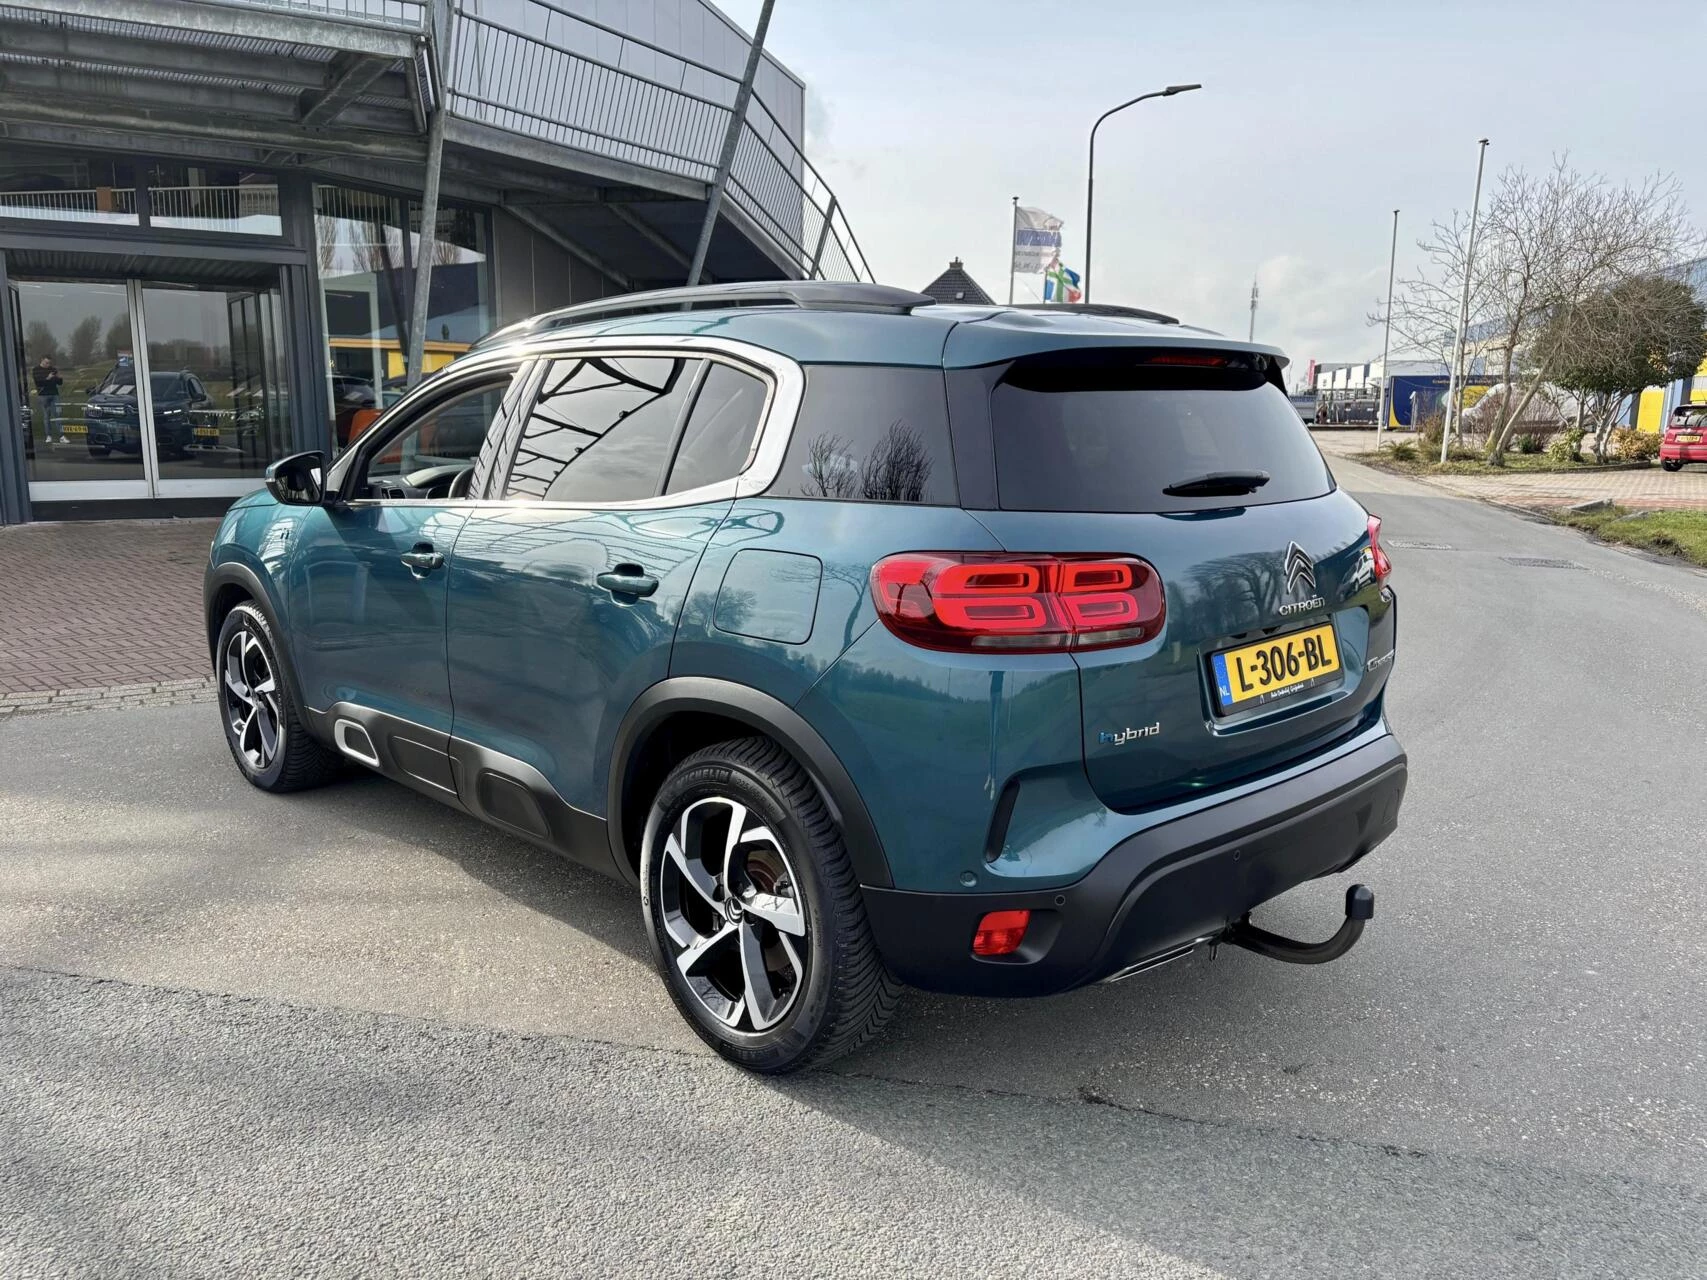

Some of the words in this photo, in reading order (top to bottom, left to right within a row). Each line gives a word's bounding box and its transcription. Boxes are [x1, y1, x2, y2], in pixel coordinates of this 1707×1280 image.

[1236, 634, 1332, 692] L-306-BL
[1219, 685, 1231, 698] NL
[1098, 722, 1160, 746] hybrid
[675, 768, 729, 787] MICHELIN
